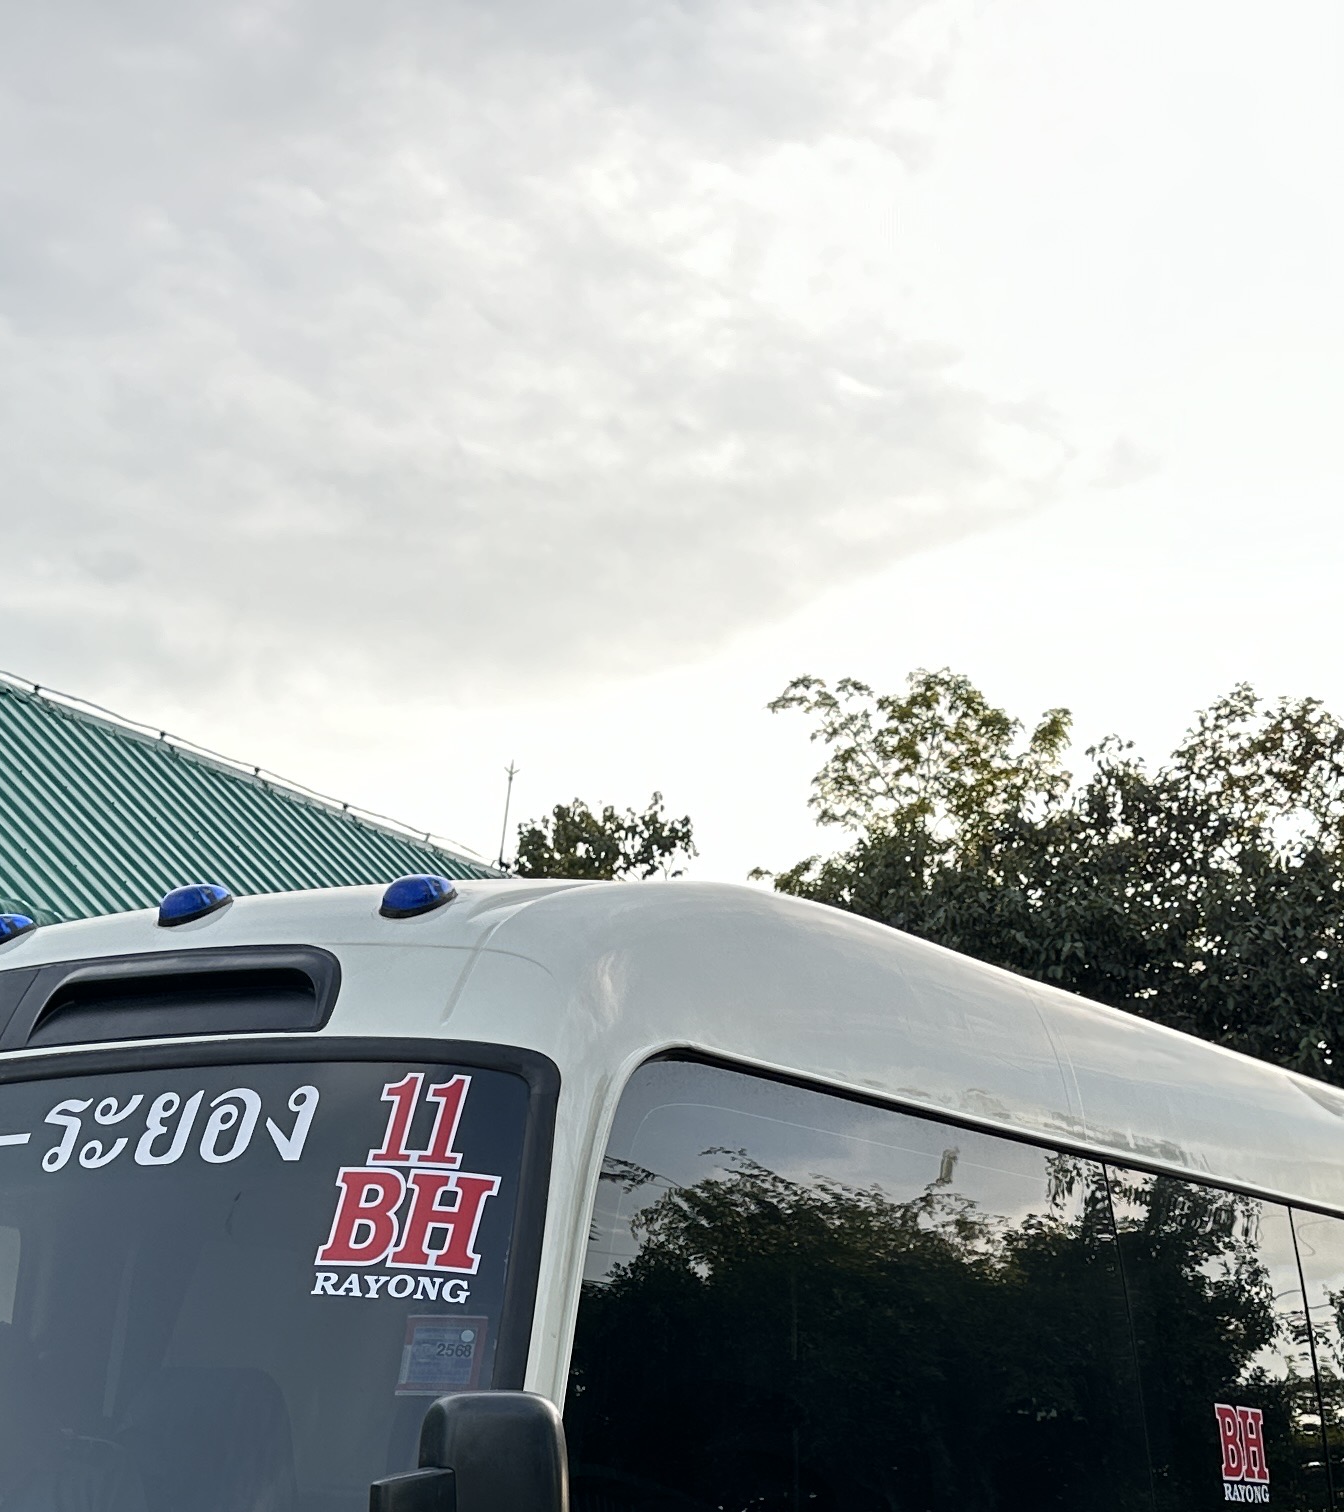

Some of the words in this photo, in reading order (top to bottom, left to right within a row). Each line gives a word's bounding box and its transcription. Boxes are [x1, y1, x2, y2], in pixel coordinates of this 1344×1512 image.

[367, 1072, 473, 1168] 11
[315, 1166, 502, 1275] BH
[310, 1272, 471, 1304] RAYONG
[436, 1343, 472, 1358] 2568
[1214, 1403, 1270, 1484] BH
[1223, 1483, 1270, 1503] RAYONG
